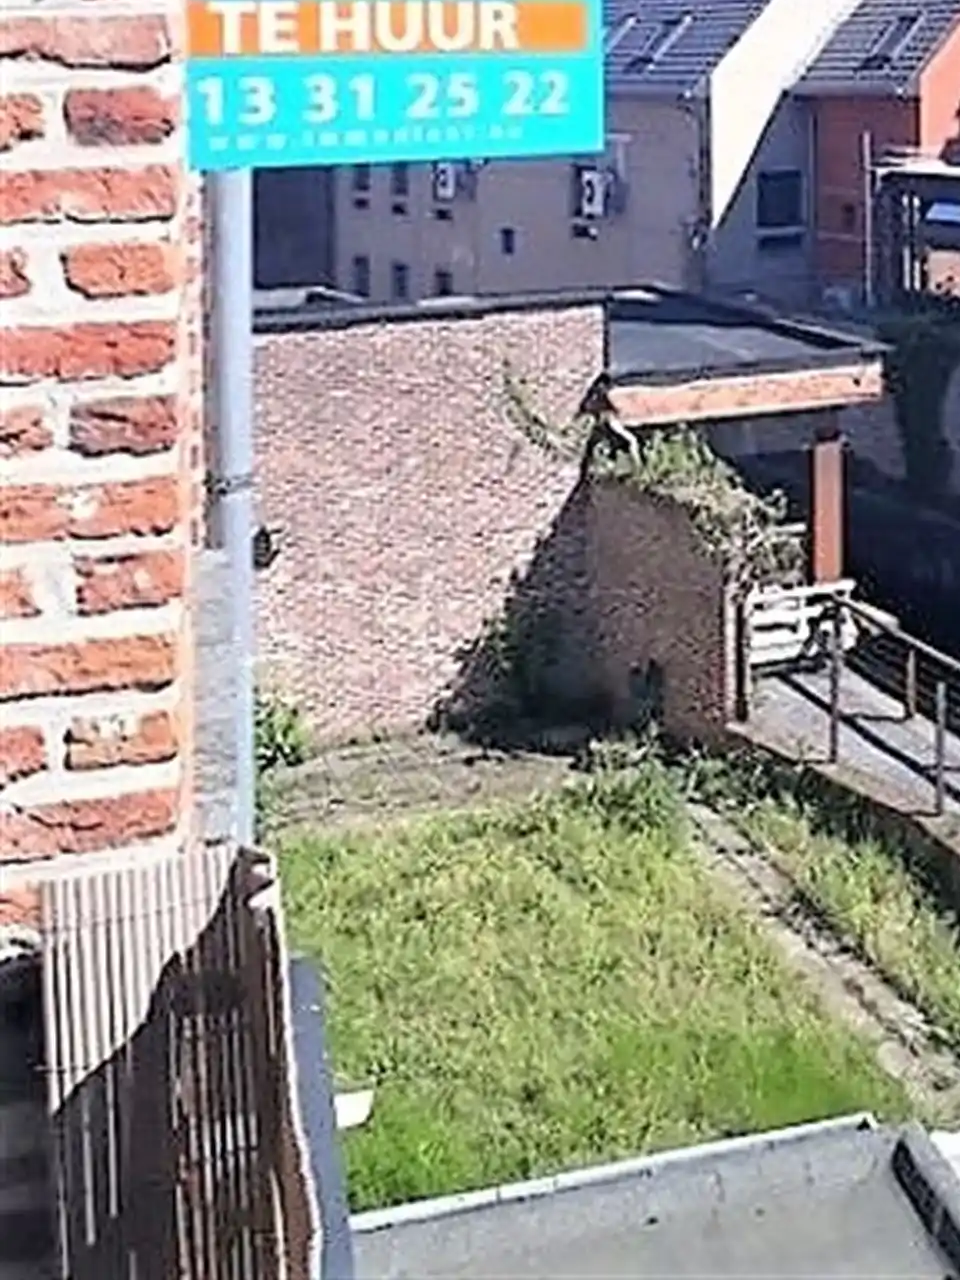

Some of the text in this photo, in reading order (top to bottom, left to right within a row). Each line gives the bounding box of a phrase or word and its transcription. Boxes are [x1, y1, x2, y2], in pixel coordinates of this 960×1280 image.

[207, 0, 520, 53] TE HUUR
[197, 69, 570, 126] 13 31 25 22
